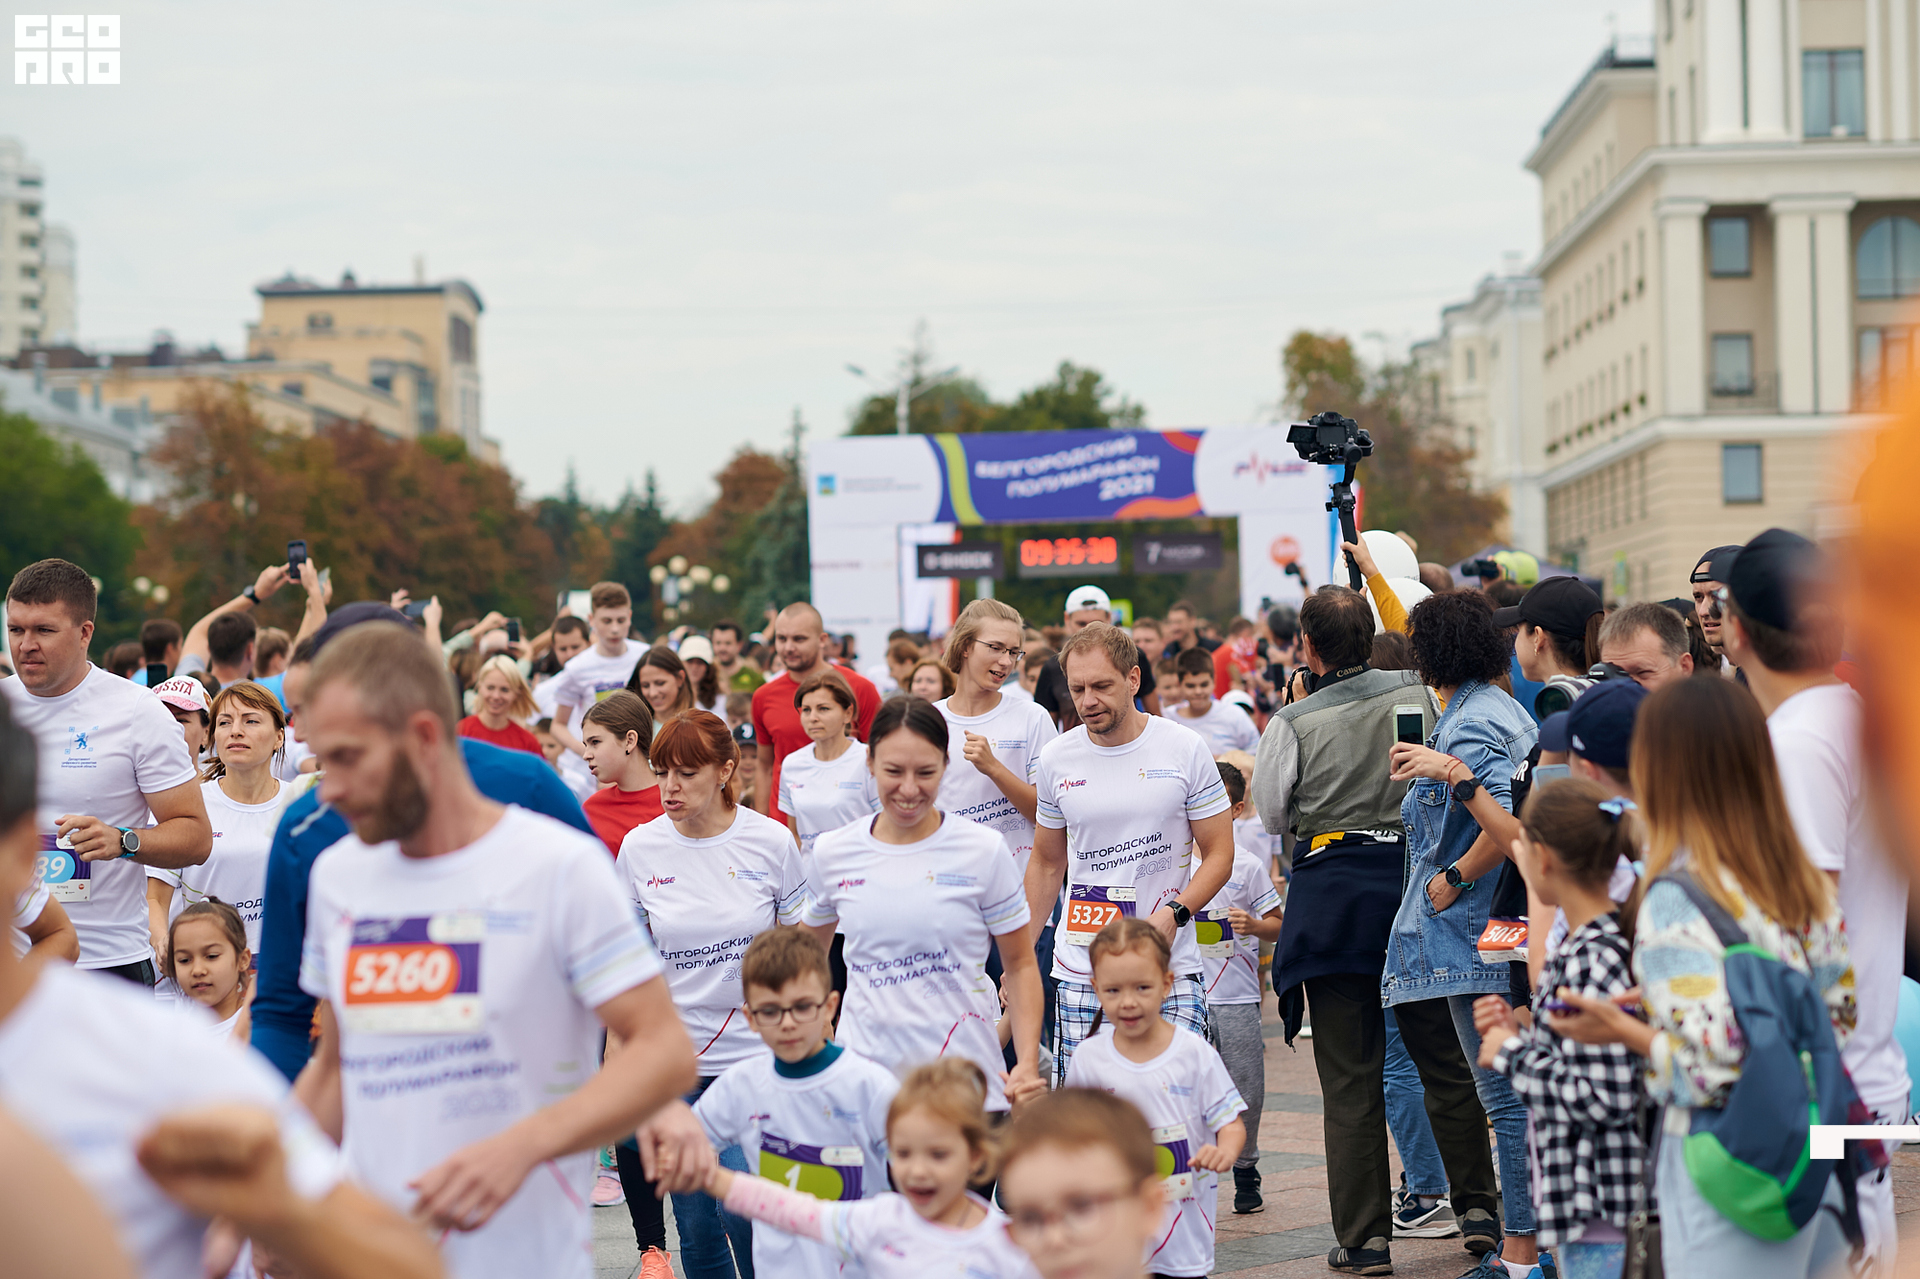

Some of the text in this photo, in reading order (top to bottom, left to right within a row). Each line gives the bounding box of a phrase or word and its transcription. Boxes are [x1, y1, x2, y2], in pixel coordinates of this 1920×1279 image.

[1098, 474, 1155, 501] 2021
[1336, 664, 1364, 678] Canon
[1091, 843, 1172, 872] ПОЛУМАРАФОН
[1136, 856, 1172, 880] 2021
[1070, 905, 1118, 926] 5327
[1482, 925, 1527, 943] 5013
[350, 949, 451, 996] 5260
[784, 1163, 802, 1191] 1
